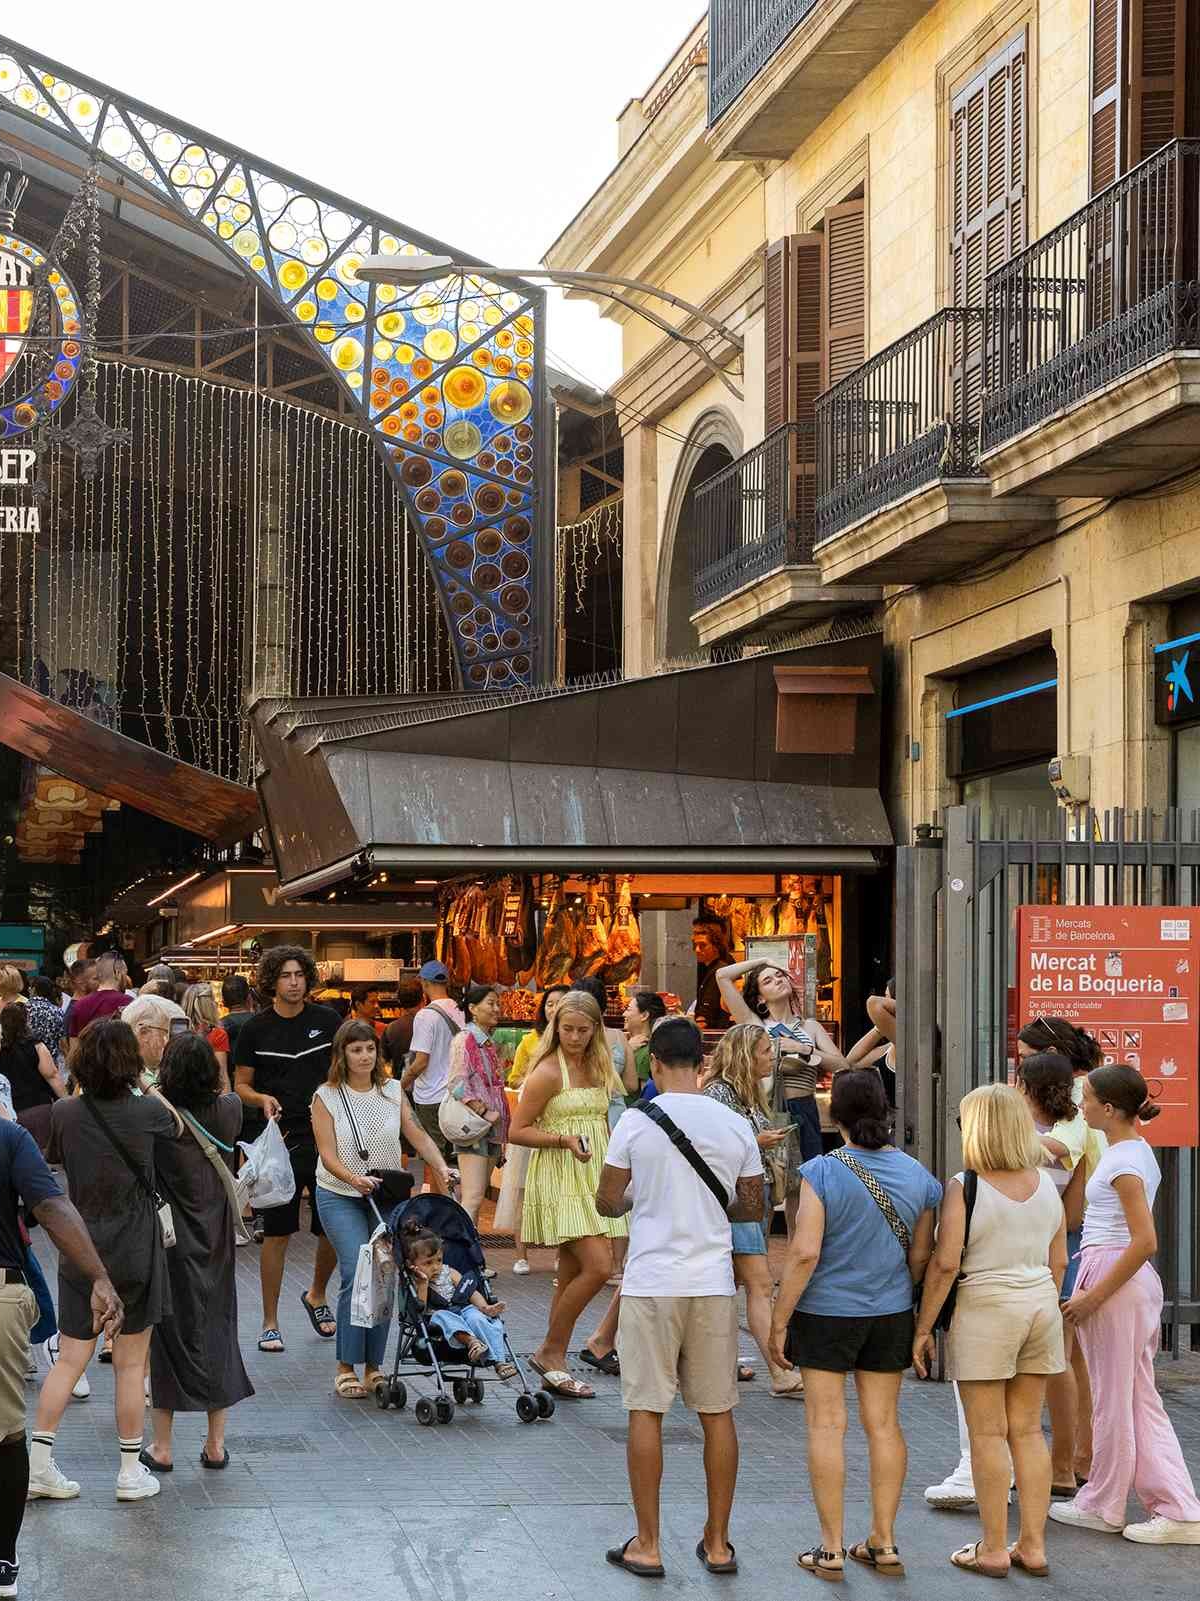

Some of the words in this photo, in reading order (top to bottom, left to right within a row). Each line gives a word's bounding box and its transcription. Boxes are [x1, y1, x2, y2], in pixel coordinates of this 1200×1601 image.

[1056, 919, 1091, 928] Mercats
[1056, 931, 1068, 940] de
[1070, 931, 1115, 941] Barcelona
[1031, 952, 1097, 971] Mercat
[1030, 974, 1053, 992] de
[1058, 974, 1073, 991] la
[1079, 974, 1164, 995] Boqueria
[1029, 1001, 1040, 1009] De
[1042, 1001, 1065, 1009] dilluns
